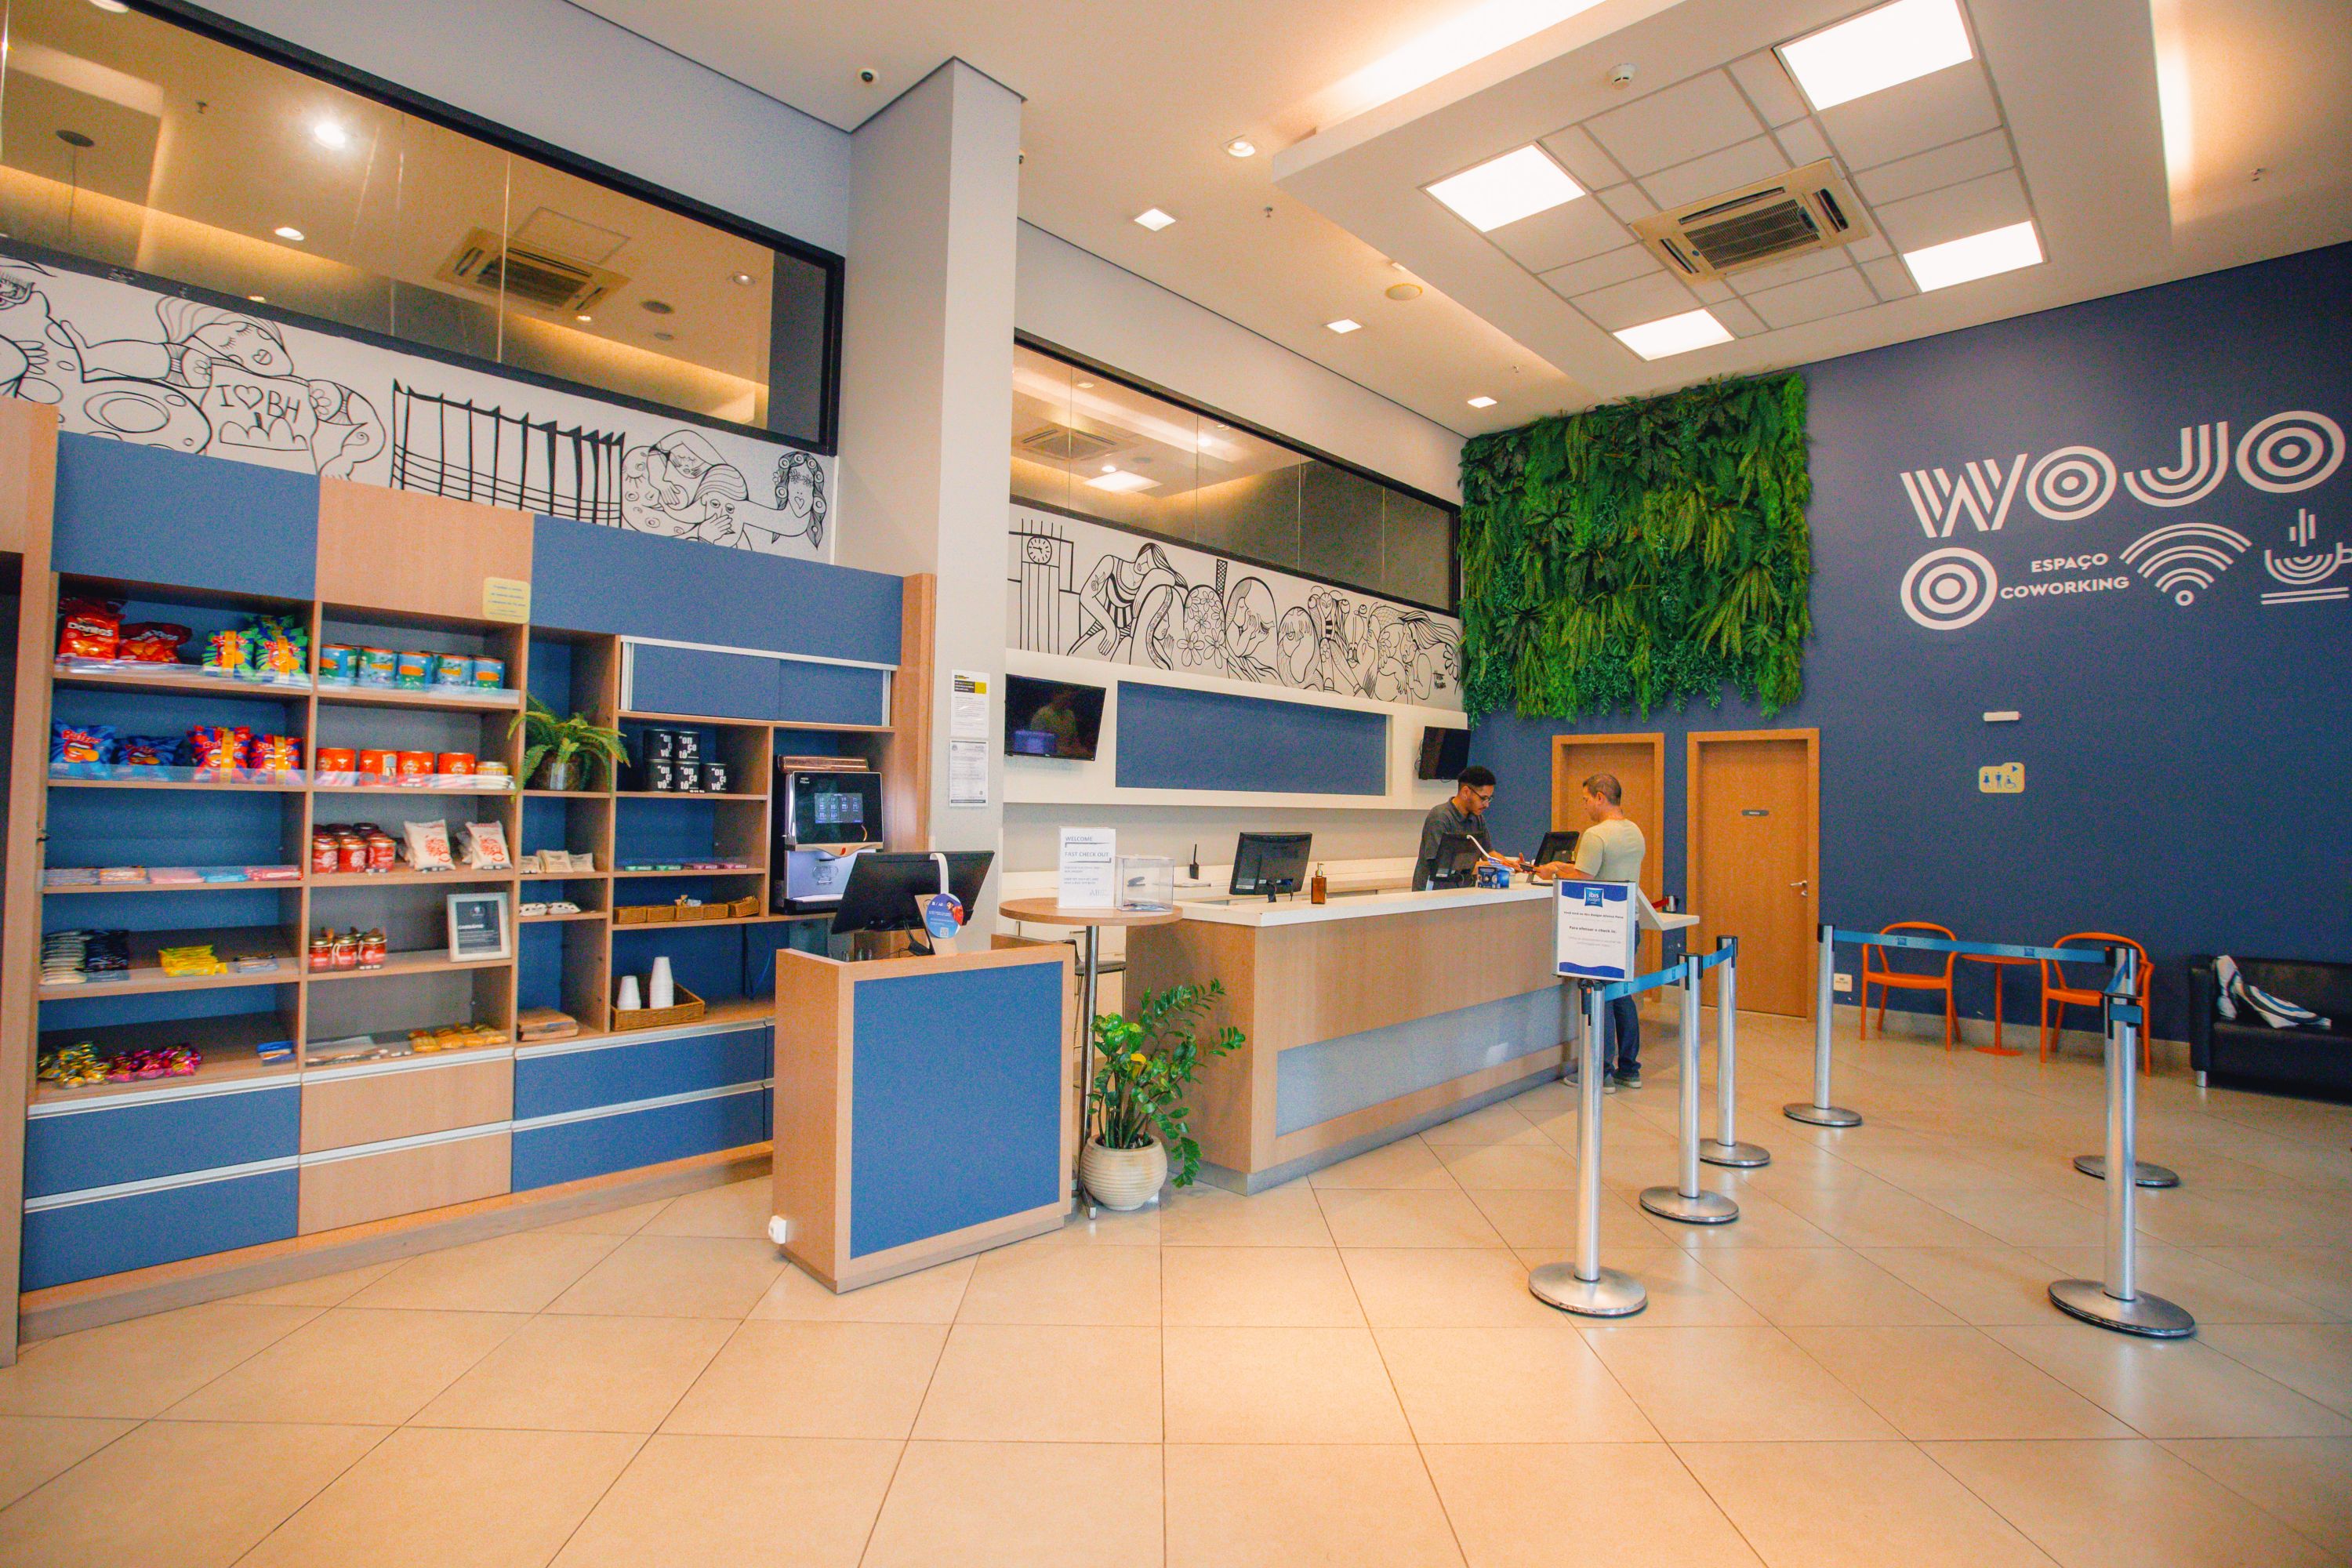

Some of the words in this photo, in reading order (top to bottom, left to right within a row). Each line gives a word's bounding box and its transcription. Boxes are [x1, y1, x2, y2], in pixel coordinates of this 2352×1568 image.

[215, 384, 235, 408] I
[267, 390, 301, 424] BH
[1900, 410, 2347, 539] WOJO
[2031, 553, 2109, 573] ESPAÇO
[2000, 576, 2131, 600] COWORKING
